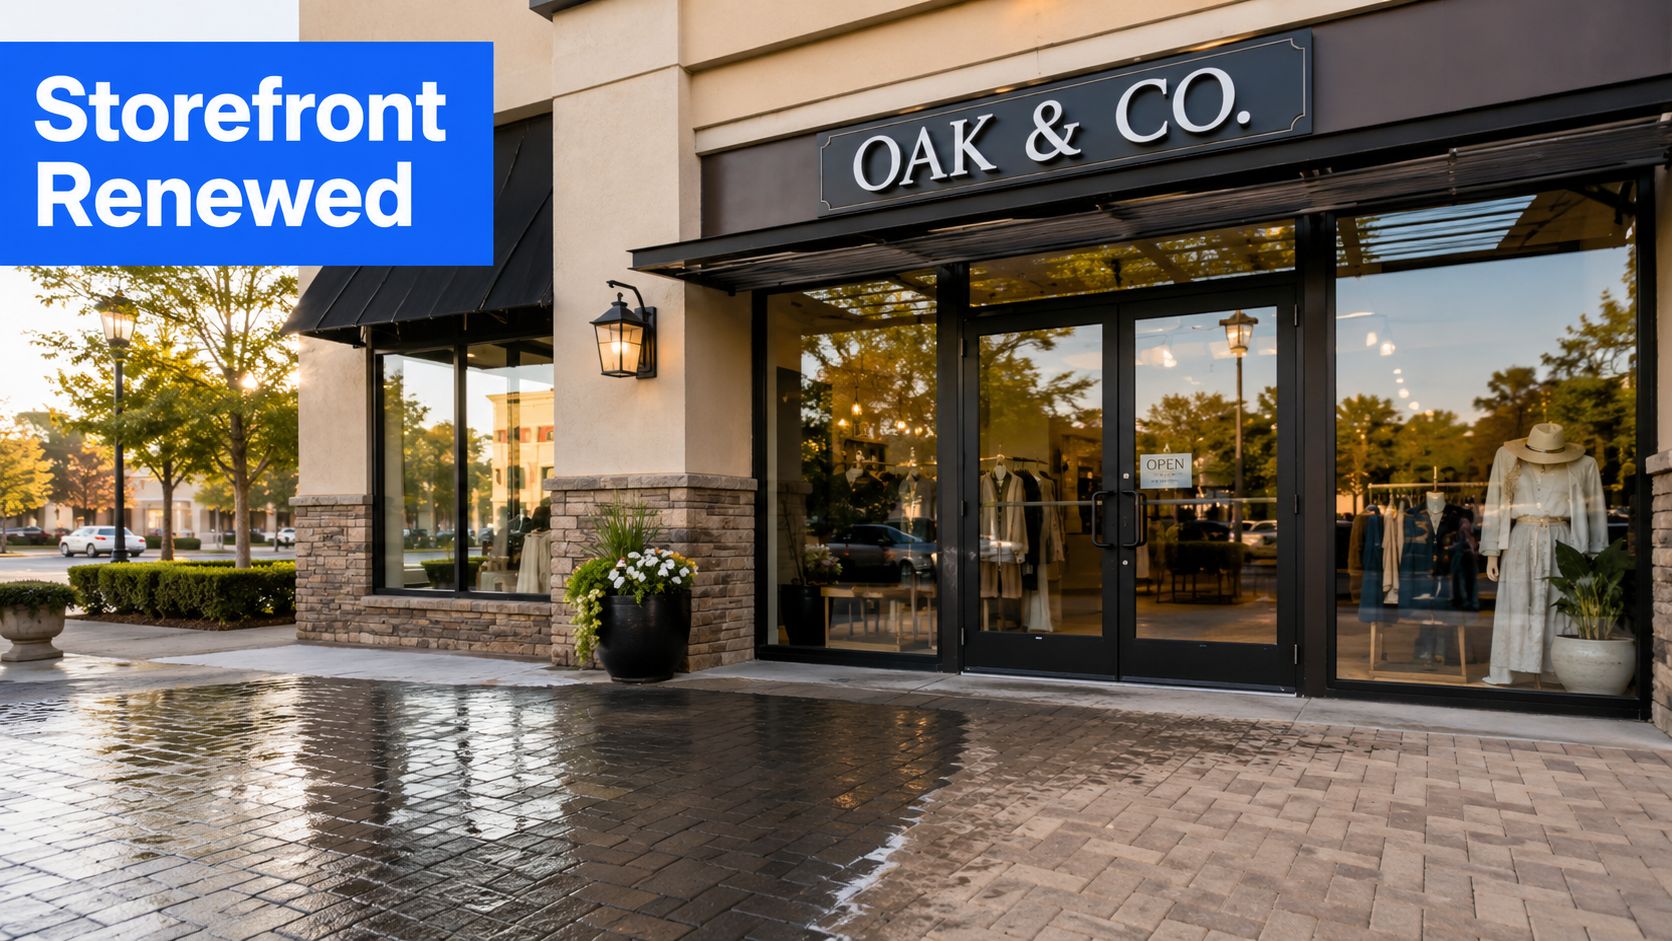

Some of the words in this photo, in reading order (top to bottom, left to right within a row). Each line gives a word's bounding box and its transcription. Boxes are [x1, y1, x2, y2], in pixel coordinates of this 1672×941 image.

[852, 113, 998, 192] OAK
[1025, 99, 1082, 162] &
[1115, 67, 1251, 143] CO.
[1146, 458, 1184, 471] OPEN
